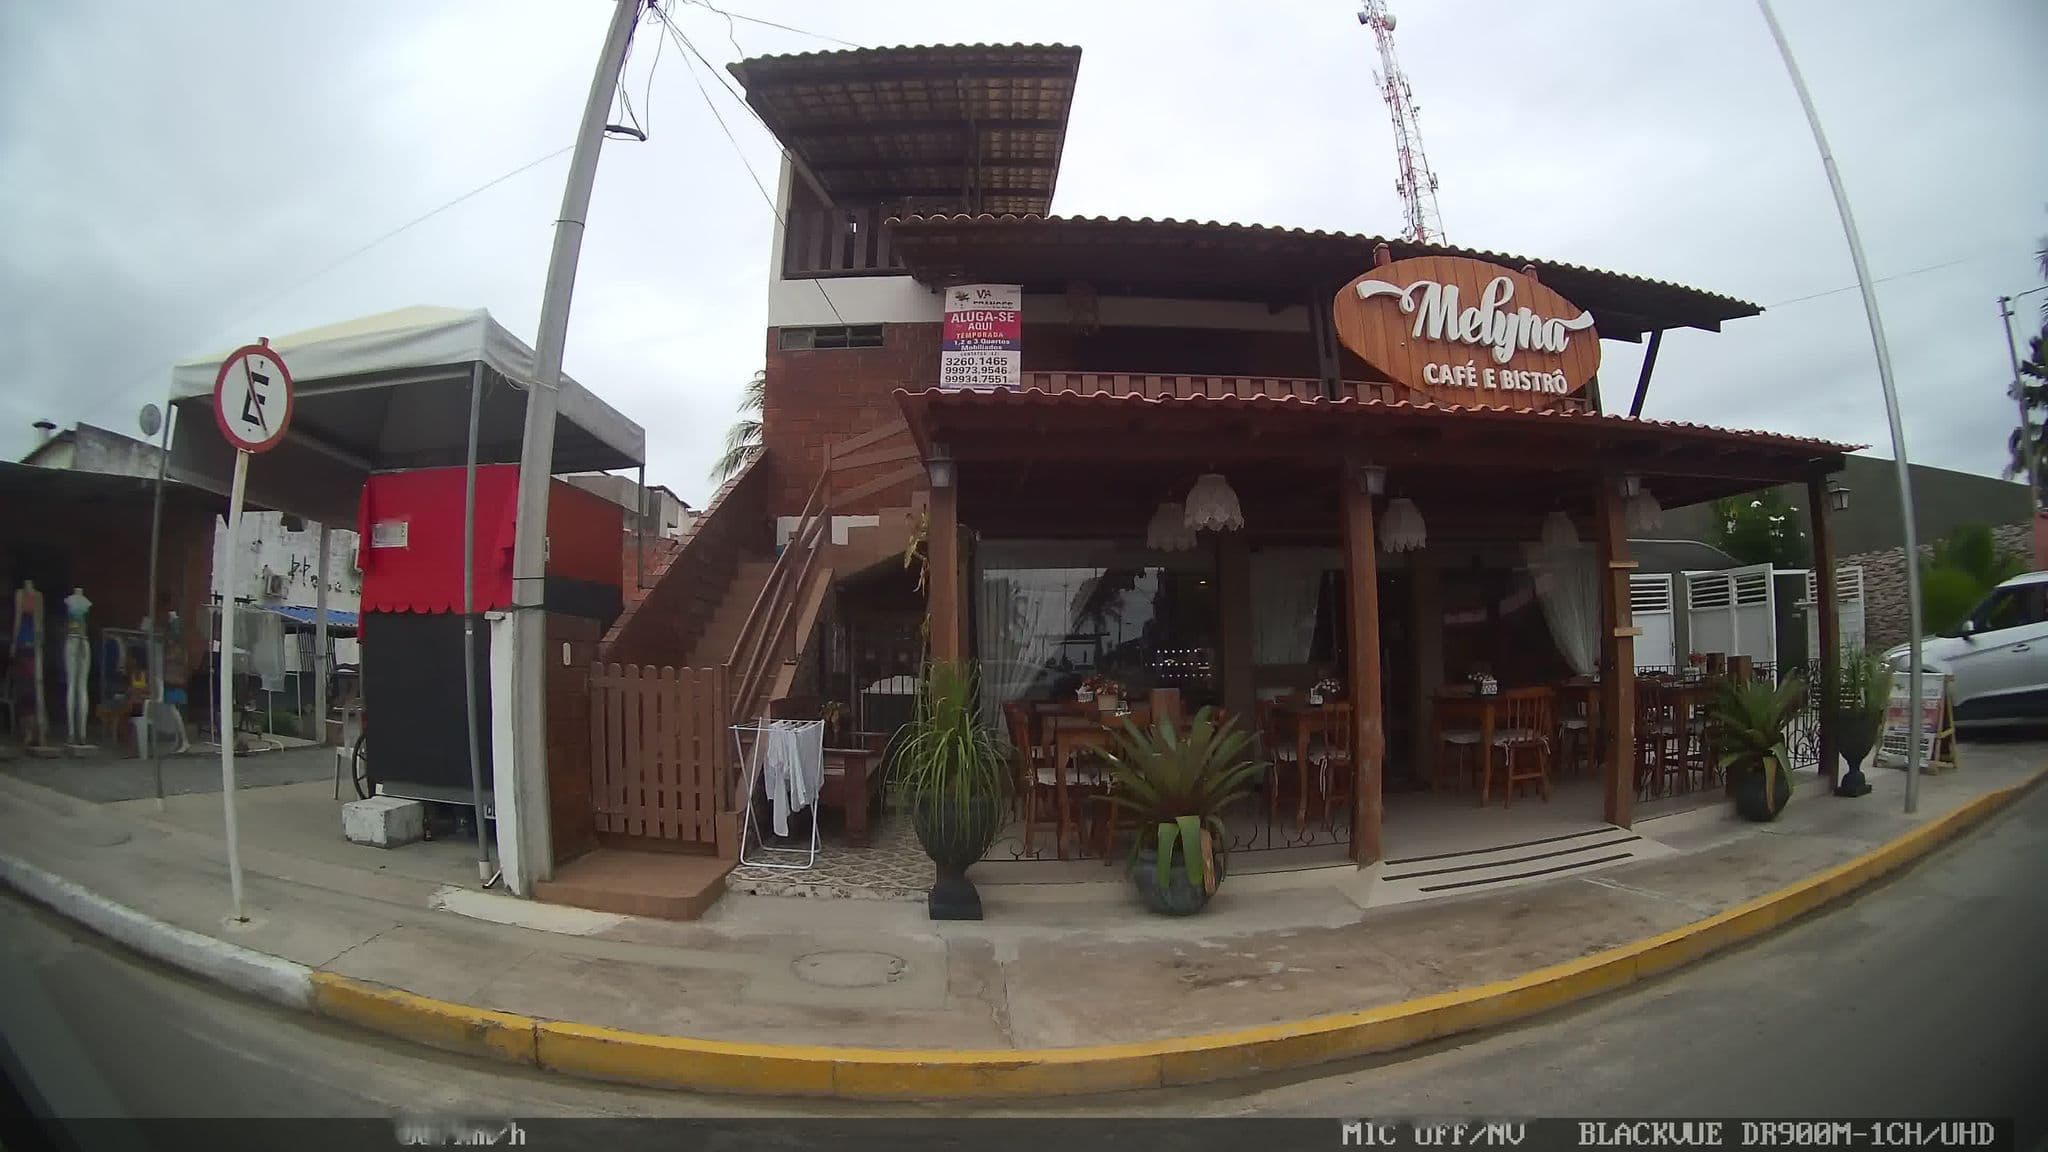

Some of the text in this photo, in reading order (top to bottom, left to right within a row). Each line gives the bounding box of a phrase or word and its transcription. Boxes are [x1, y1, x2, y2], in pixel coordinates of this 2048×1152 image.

[951, 311, 1015, 323] ALUGA-SE
[1356, 276, 1594, 363] Melyna
[967, 322, 992, 331] AQUI
[956, 331, 1003, 339] TEMPORADA
[945, 357, 1008, 366] 3260.1465
[945, 366, 1008, 375] 99973.9546
[944, 375, 1008, 383] 99934.7551
[1423, 360, 1568, 395] CAFÉ E BISTRÔ
